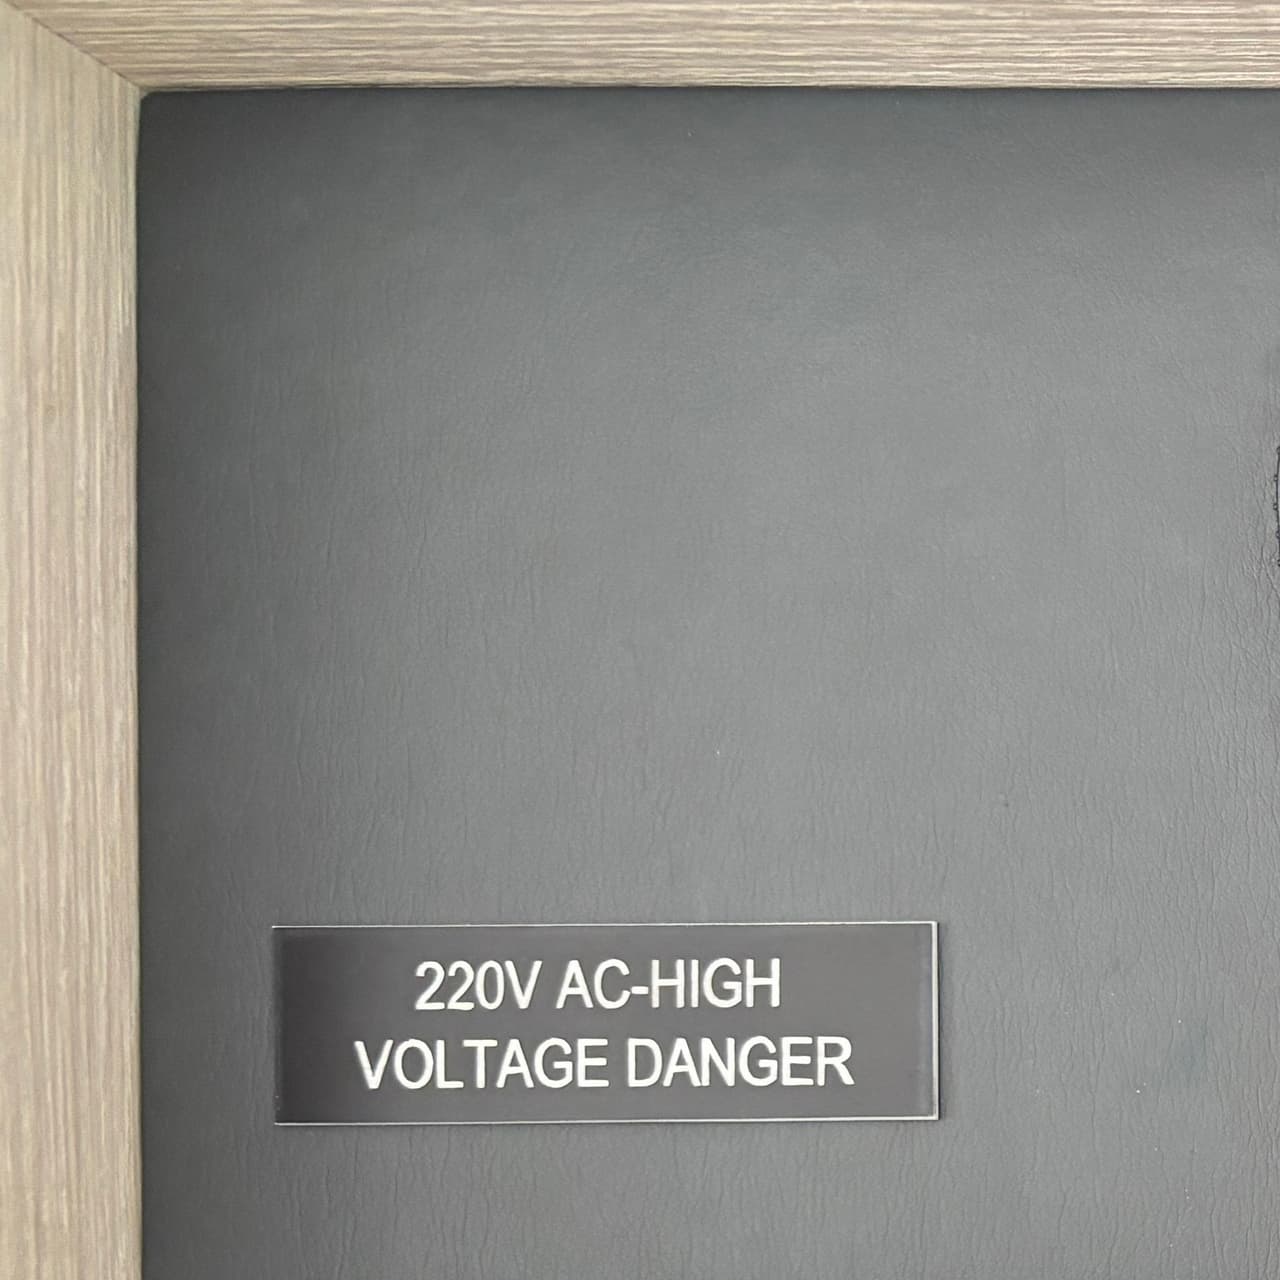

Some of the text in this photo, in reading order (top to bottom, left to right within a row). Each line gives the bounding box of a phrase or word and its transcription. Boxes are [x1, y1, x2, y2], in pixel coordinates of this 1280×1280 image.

[416, 958, 780, 1010] 220V AC-HIGH
[355, 1036, 854, 1089] VOLTAGE DANGER
